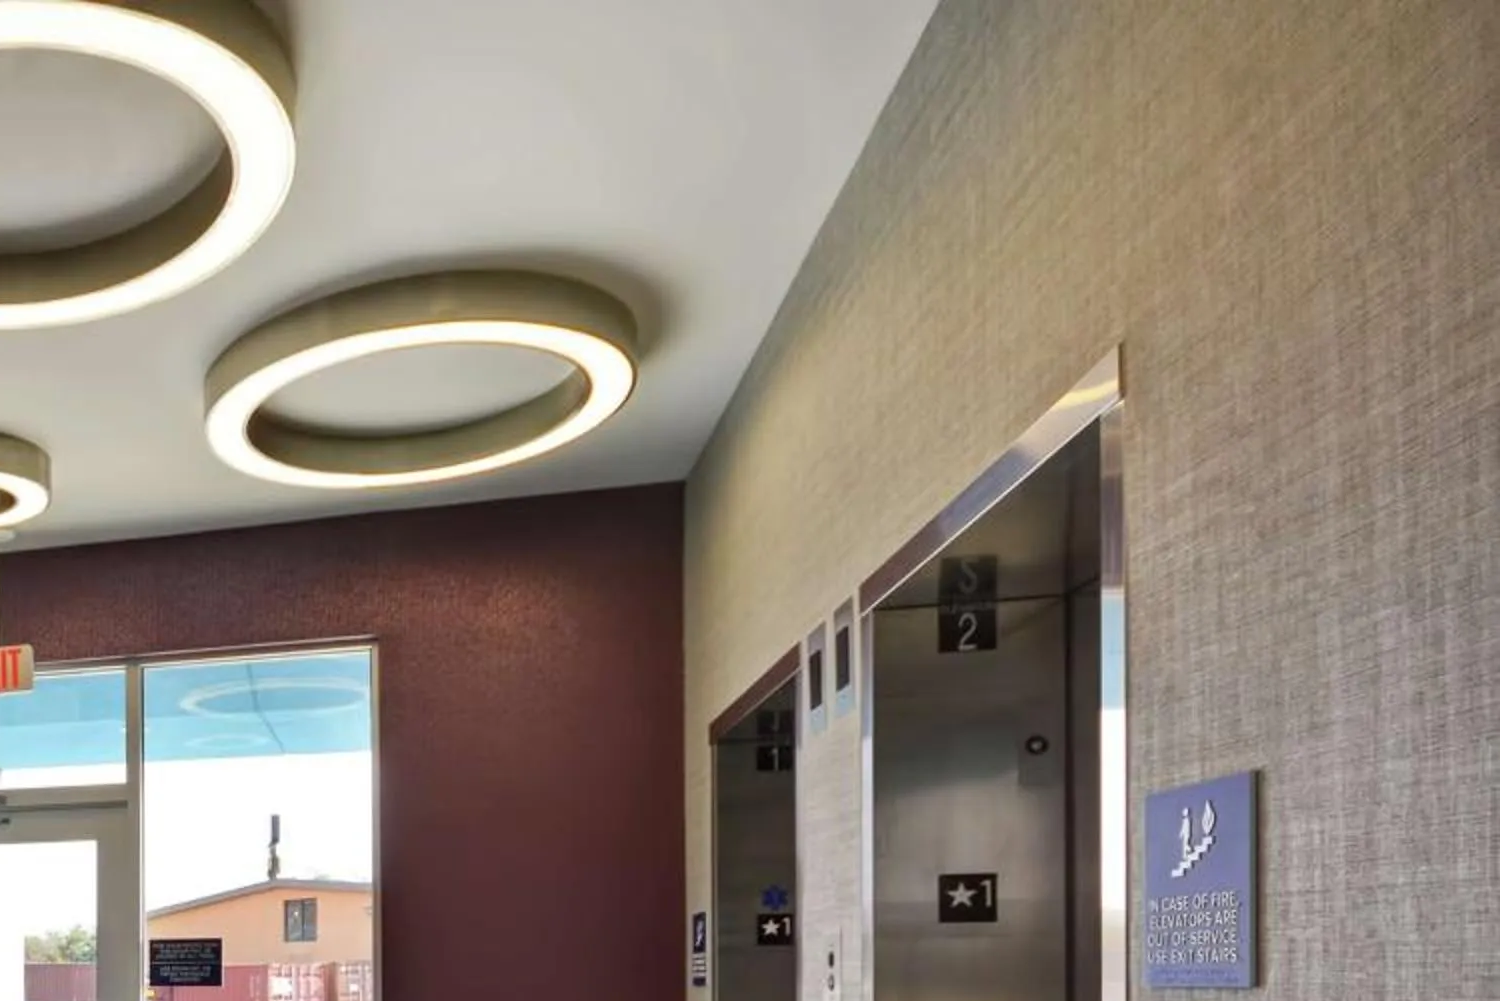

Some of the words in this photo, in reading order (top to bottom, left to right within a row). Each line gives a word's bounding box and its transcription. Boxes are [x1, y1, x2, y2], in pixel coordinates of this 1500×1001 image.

[958, 612, 978, 651] 2
[980, 880, 992, 908] 1
[1161, 895, 1189, 912] CASE
[1192, 893, 1209, 910] OF
[782, 916, 792, 936] 1
[1150, 911, 1213, 932] ELEVATORS
[1215, 909, 1237, 926] ARE
[1147, 931, 1169, 948] OUT
[1171, 930, 1187, 947] OF
[1147, 949, 1168, 965] USE
[1171, 947, 1194, 964] EXIT
[1196, 945, 1237, 963] STAIRS
